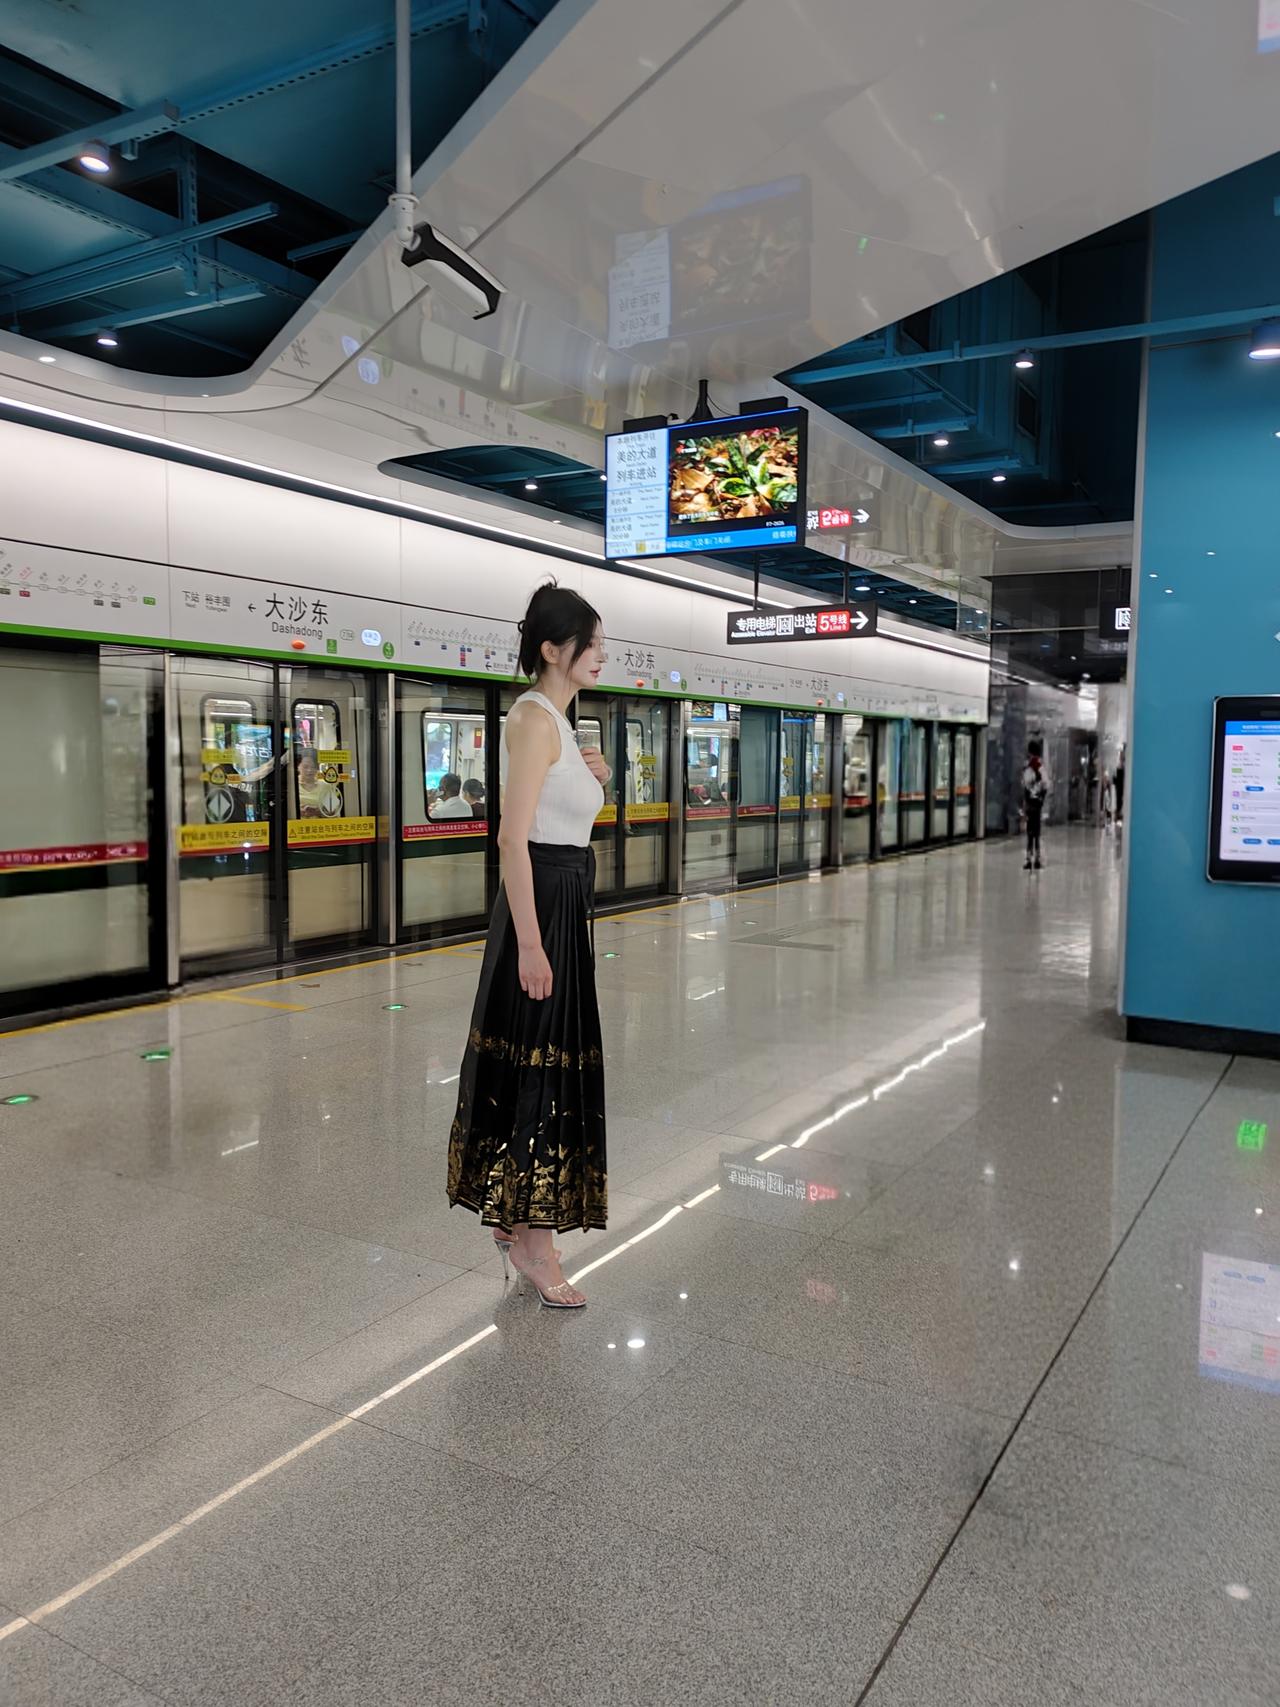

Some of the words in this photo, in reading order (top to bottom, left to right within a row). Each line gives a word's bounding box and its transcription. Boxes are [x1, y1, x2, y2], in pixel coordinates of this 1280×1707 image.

[617, 466, 657, 482] 列车进站
[182, 590, 200, 603] 下站
[265, 593, 329, 625] 大沙东
[272, 621, 323, 640] Dashadong
[736, 616, 777, 632] 专用电梯
[794, 613, 817, 628] 出站
[624, 648, 656, 670] 大沙东
